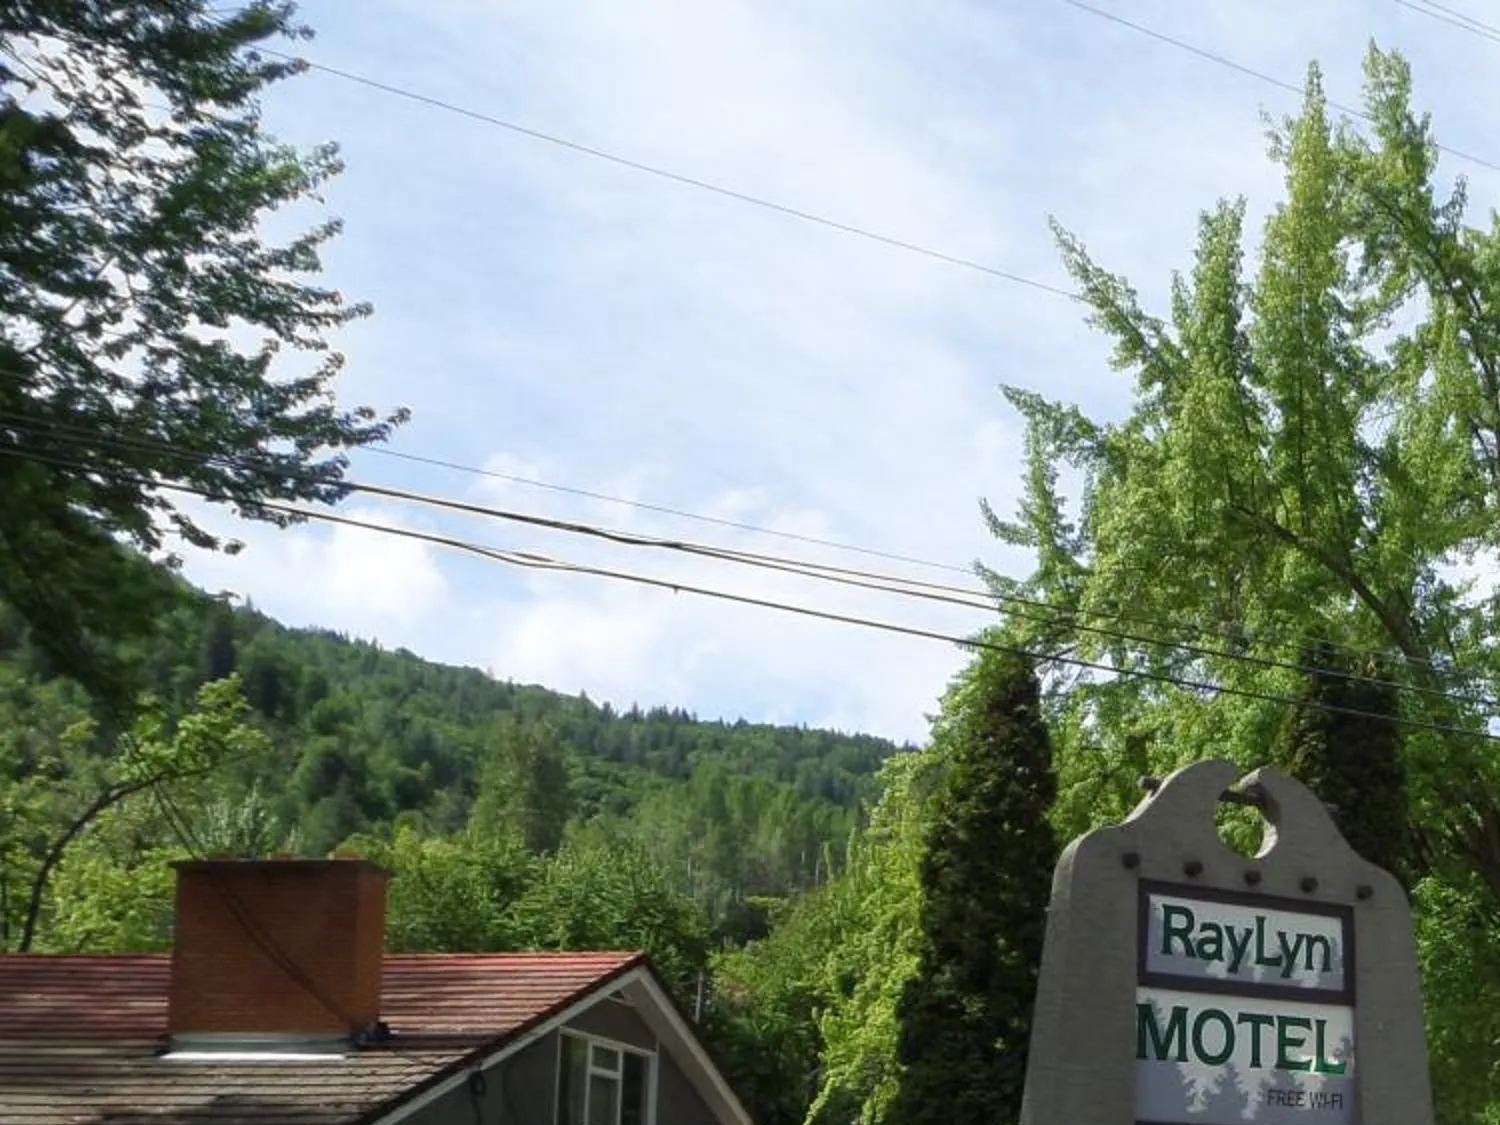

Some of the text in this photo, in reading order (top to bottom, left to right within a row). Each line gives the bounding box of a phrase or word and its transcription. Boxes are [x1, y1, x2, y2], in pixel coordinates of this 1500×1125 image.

[1160, 903, 1332, 978] RayLyn
[1135, 1003, 1347, 1075] MOTEL
[1267, 1088, 1305, 1107] FREE
